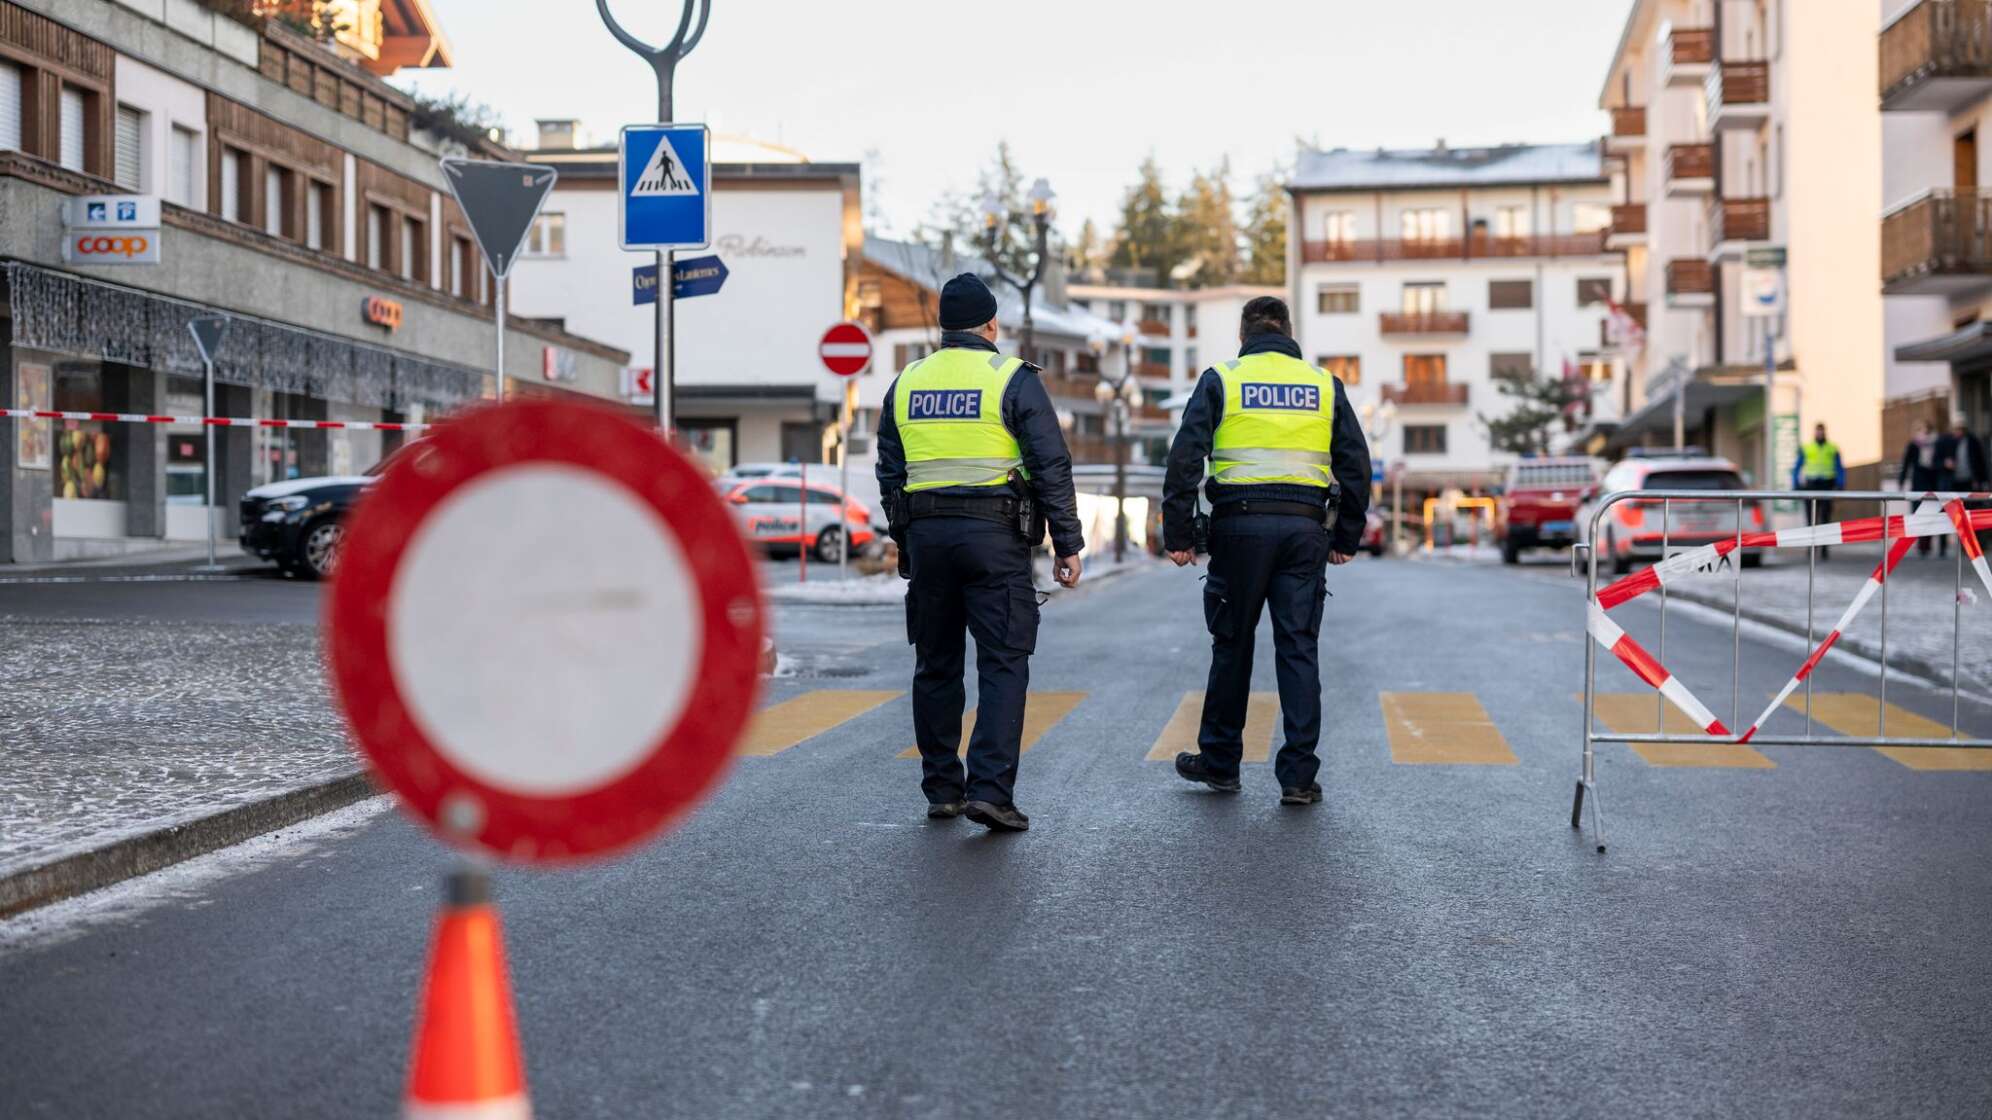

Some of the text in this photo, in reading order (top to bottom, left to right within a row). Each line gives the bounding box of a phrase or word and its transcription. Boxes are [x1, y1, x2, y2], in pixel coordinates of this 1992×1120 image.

[77, 235, 147, 257] coop
[911, 393, 978, 416] POLICE
[1244, 385, 1317, 408] POLICE
